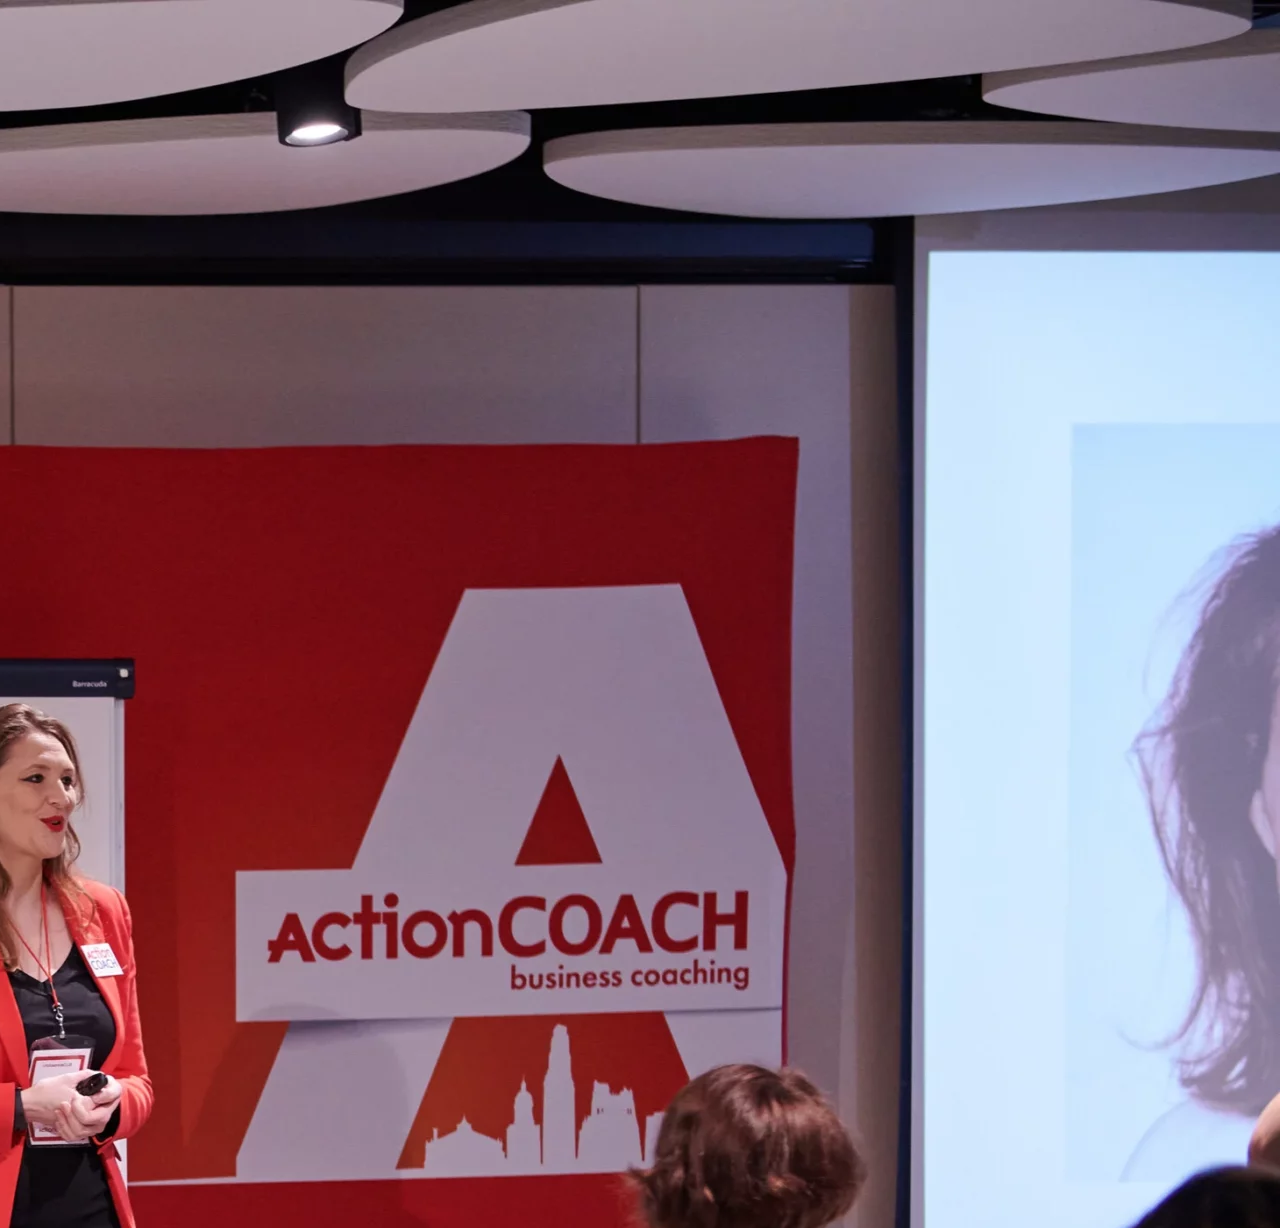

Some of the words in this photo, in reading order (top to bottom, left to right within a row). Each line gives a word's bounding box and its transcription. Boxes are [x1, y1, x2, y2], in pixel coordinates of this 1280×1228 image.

[72, 680, 107, 688] Barracuda
[267, 890, 749, 963] ActionCOACH
[510, 965, 623, 991] business
[630, 960, 750, 991] coaching
